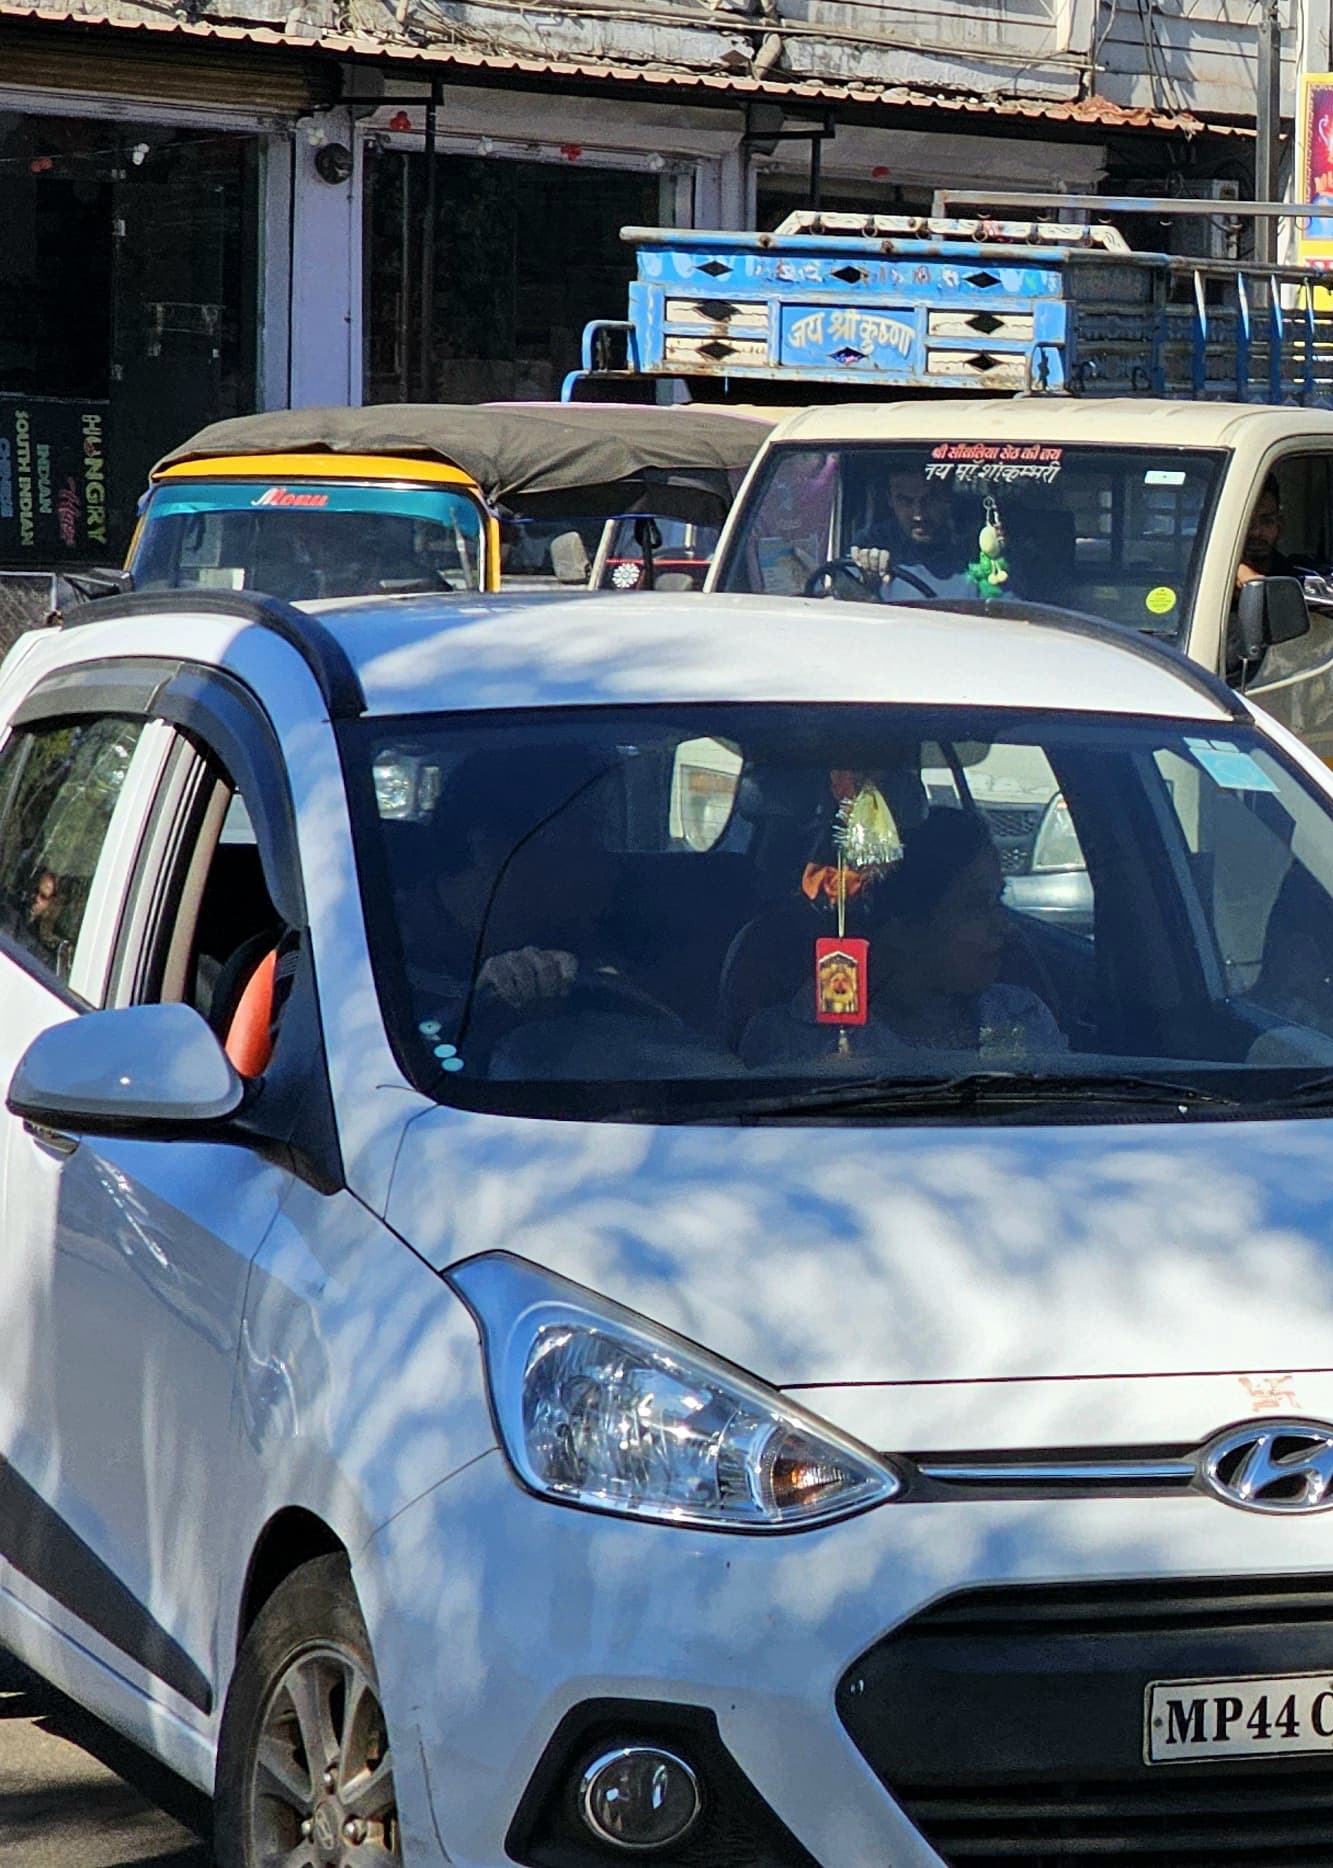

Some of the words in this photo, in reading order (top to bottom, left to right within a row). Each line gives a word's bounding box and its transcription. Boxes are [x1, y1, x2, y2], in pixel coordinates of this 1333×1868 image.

[787, 311, 825, 348] जय
[15, 410, 32, 472] SOUTH
[18, 477, 34, 546] INDIAN
[36, 443, 52, 513] INDIAN
[81, 414, 107, 545] HUNGRY
